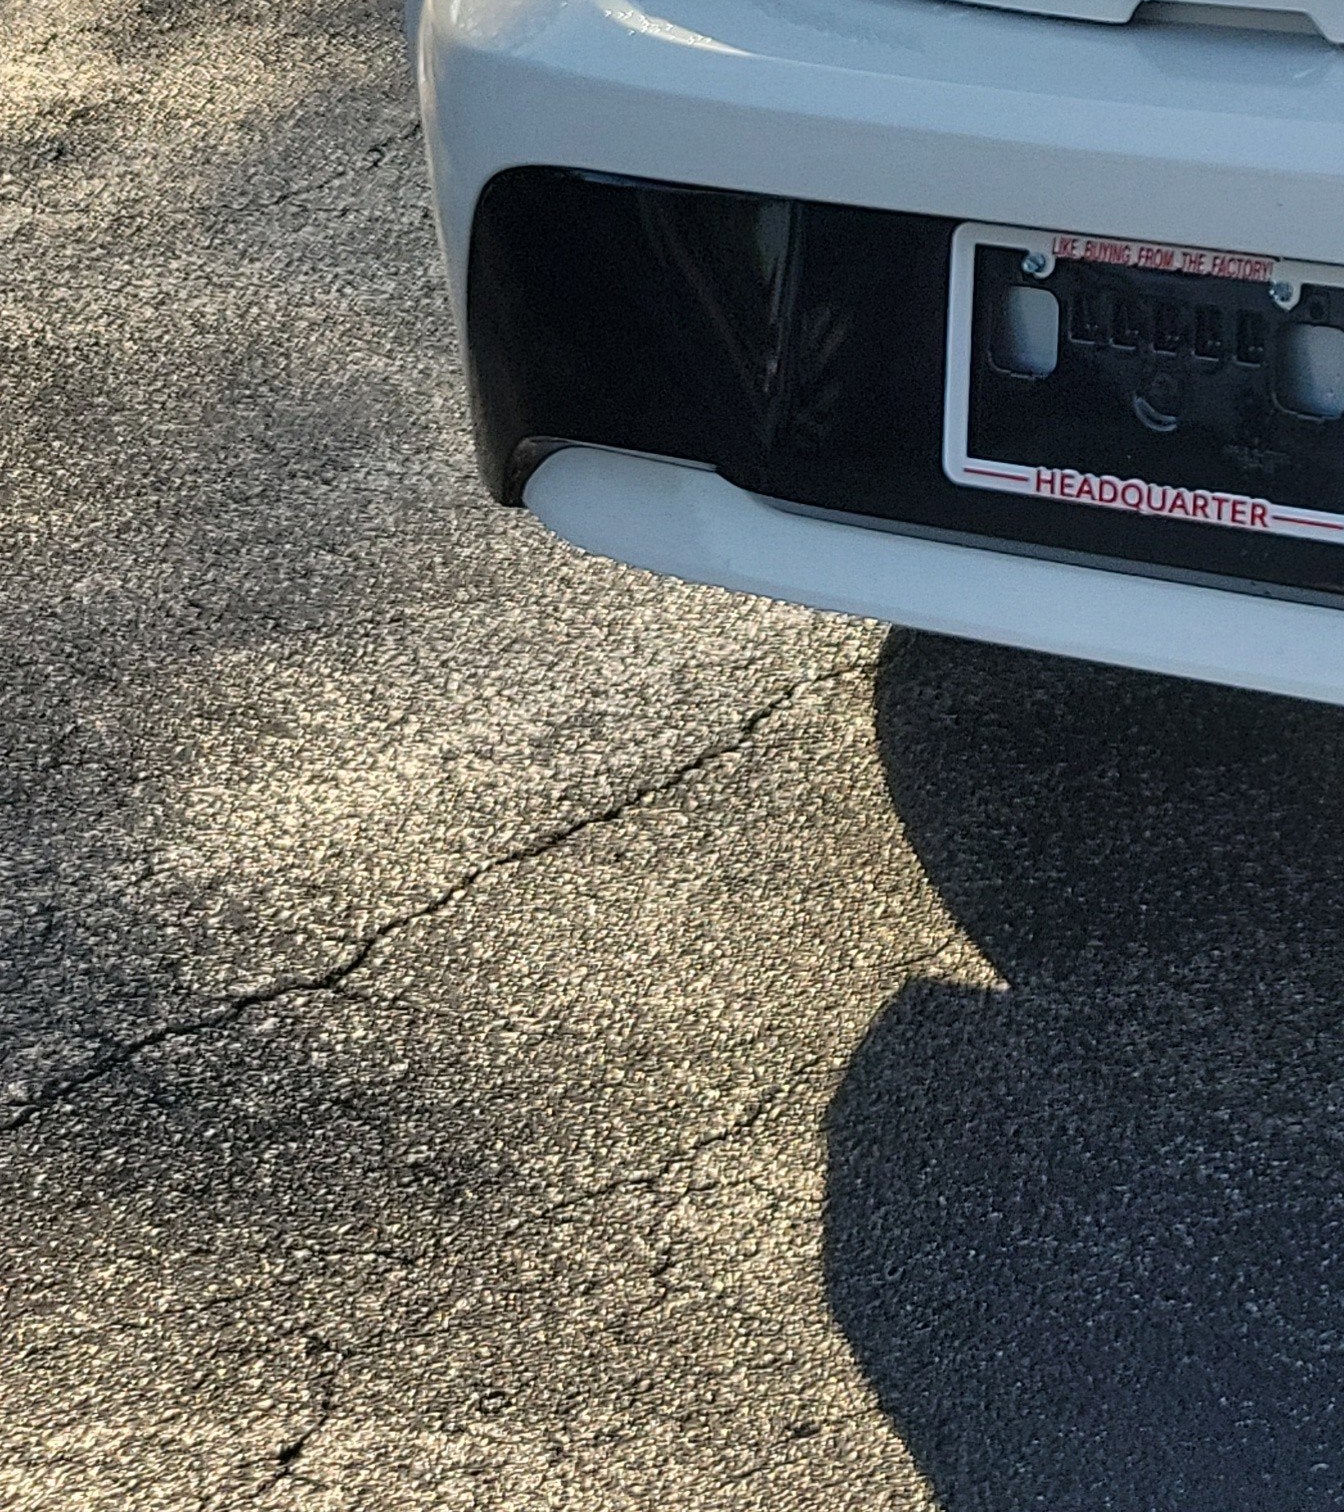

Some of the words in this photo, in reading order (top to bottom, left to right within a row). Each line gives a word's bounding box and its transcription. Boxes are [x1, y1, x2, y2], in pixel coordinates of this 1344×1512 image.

[1052, 236, 1077, 258] LIKE
[1083, 240, 1131, 265] BUYING
[1137, 246, 1175, 269] FROM
[1181, 251, 1205, 274] THE
[1035, 469, 1269, 529] HEADQUARTER
